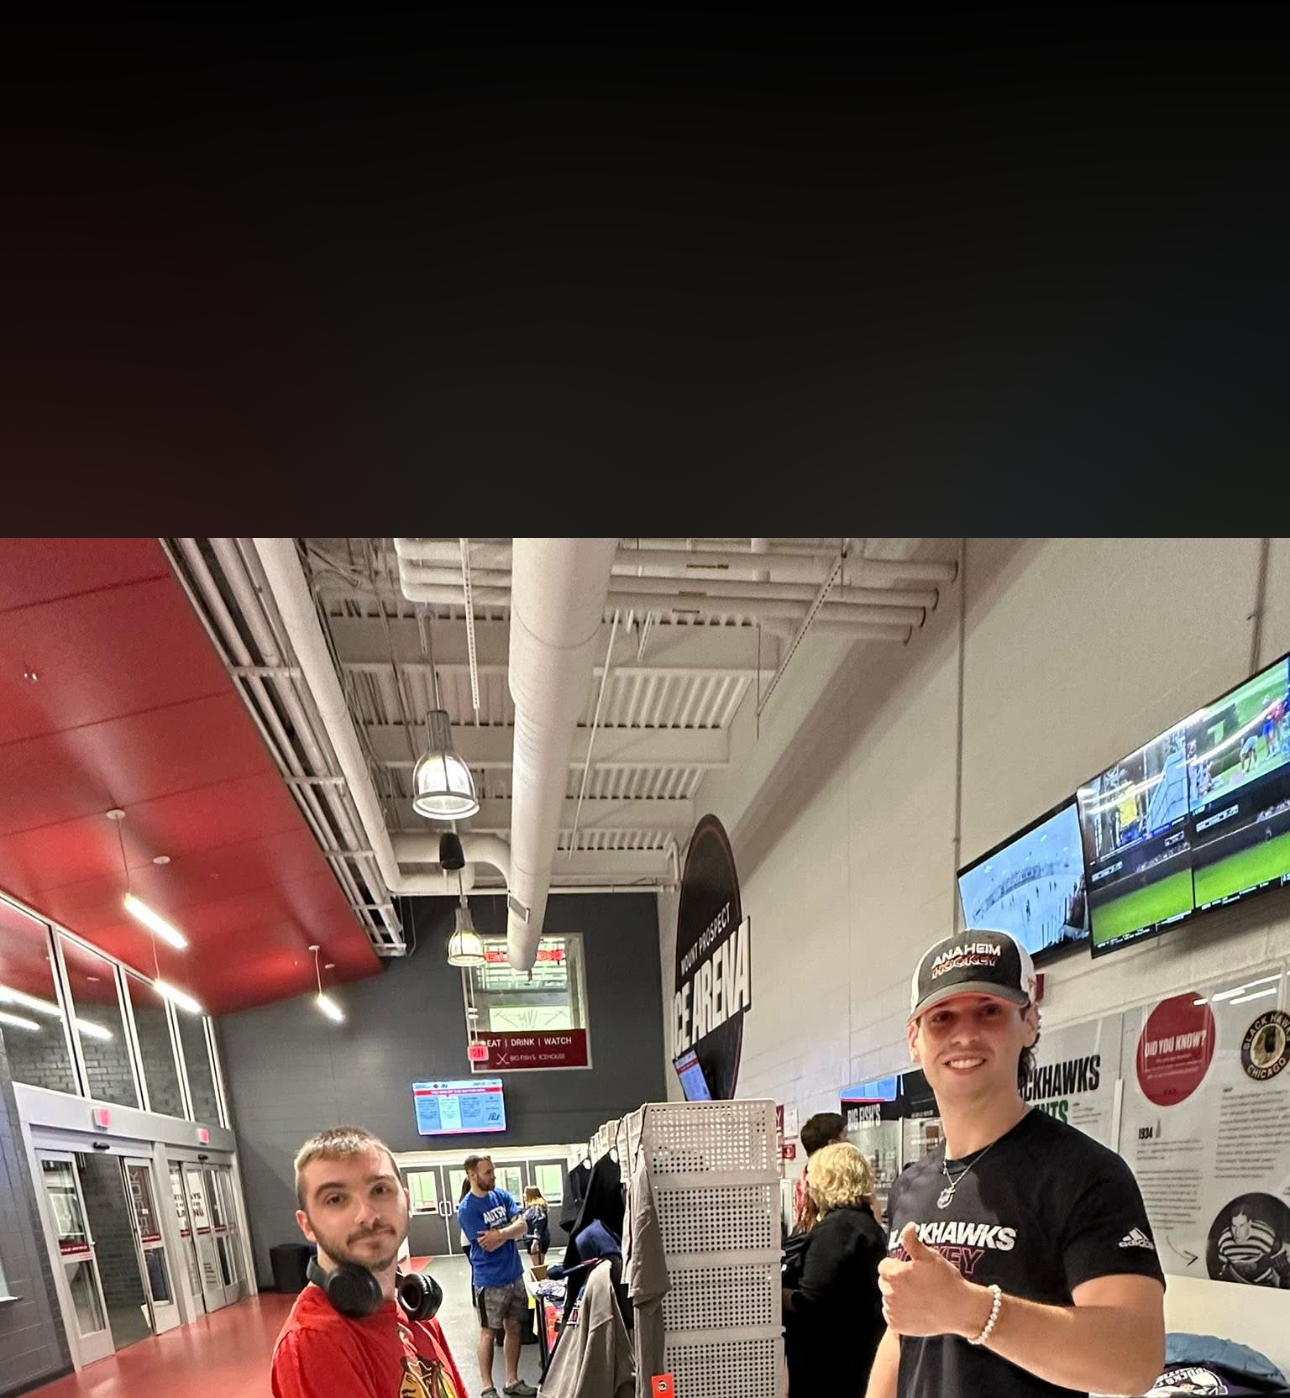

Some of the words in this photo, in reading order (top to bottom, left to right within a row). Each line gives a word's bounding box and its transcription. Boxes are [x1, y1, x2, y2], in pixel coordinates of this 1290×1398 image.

[680, 941, 699, 977] MOUNT
[699, 901, 731, 952] PROSPECT
[931, 942, 1001, 970] ANAHEIM
[931, 954, 998, 980] HOCKEY
[671, 981, 691, 1061] ICE
[691, 917, 751, 1046] ARENA
[486, 1039, 501, 1048] EAT
[510, 1038, 535, 1047] DRINK
[543, 1036, 572, 1045] WATCH
[1144, 1040, 1158, 1058] DID
[1158, 1036, 1175, 1055] YOU
[1175, 1029, 1207, 1051] KNOW?
[1242, 1015, 1268, 1050] BLACK
[1019, 1054, 1101, 1102] CKHAWKS
[1247, 1056, 1287, 1079] CHICAGO
